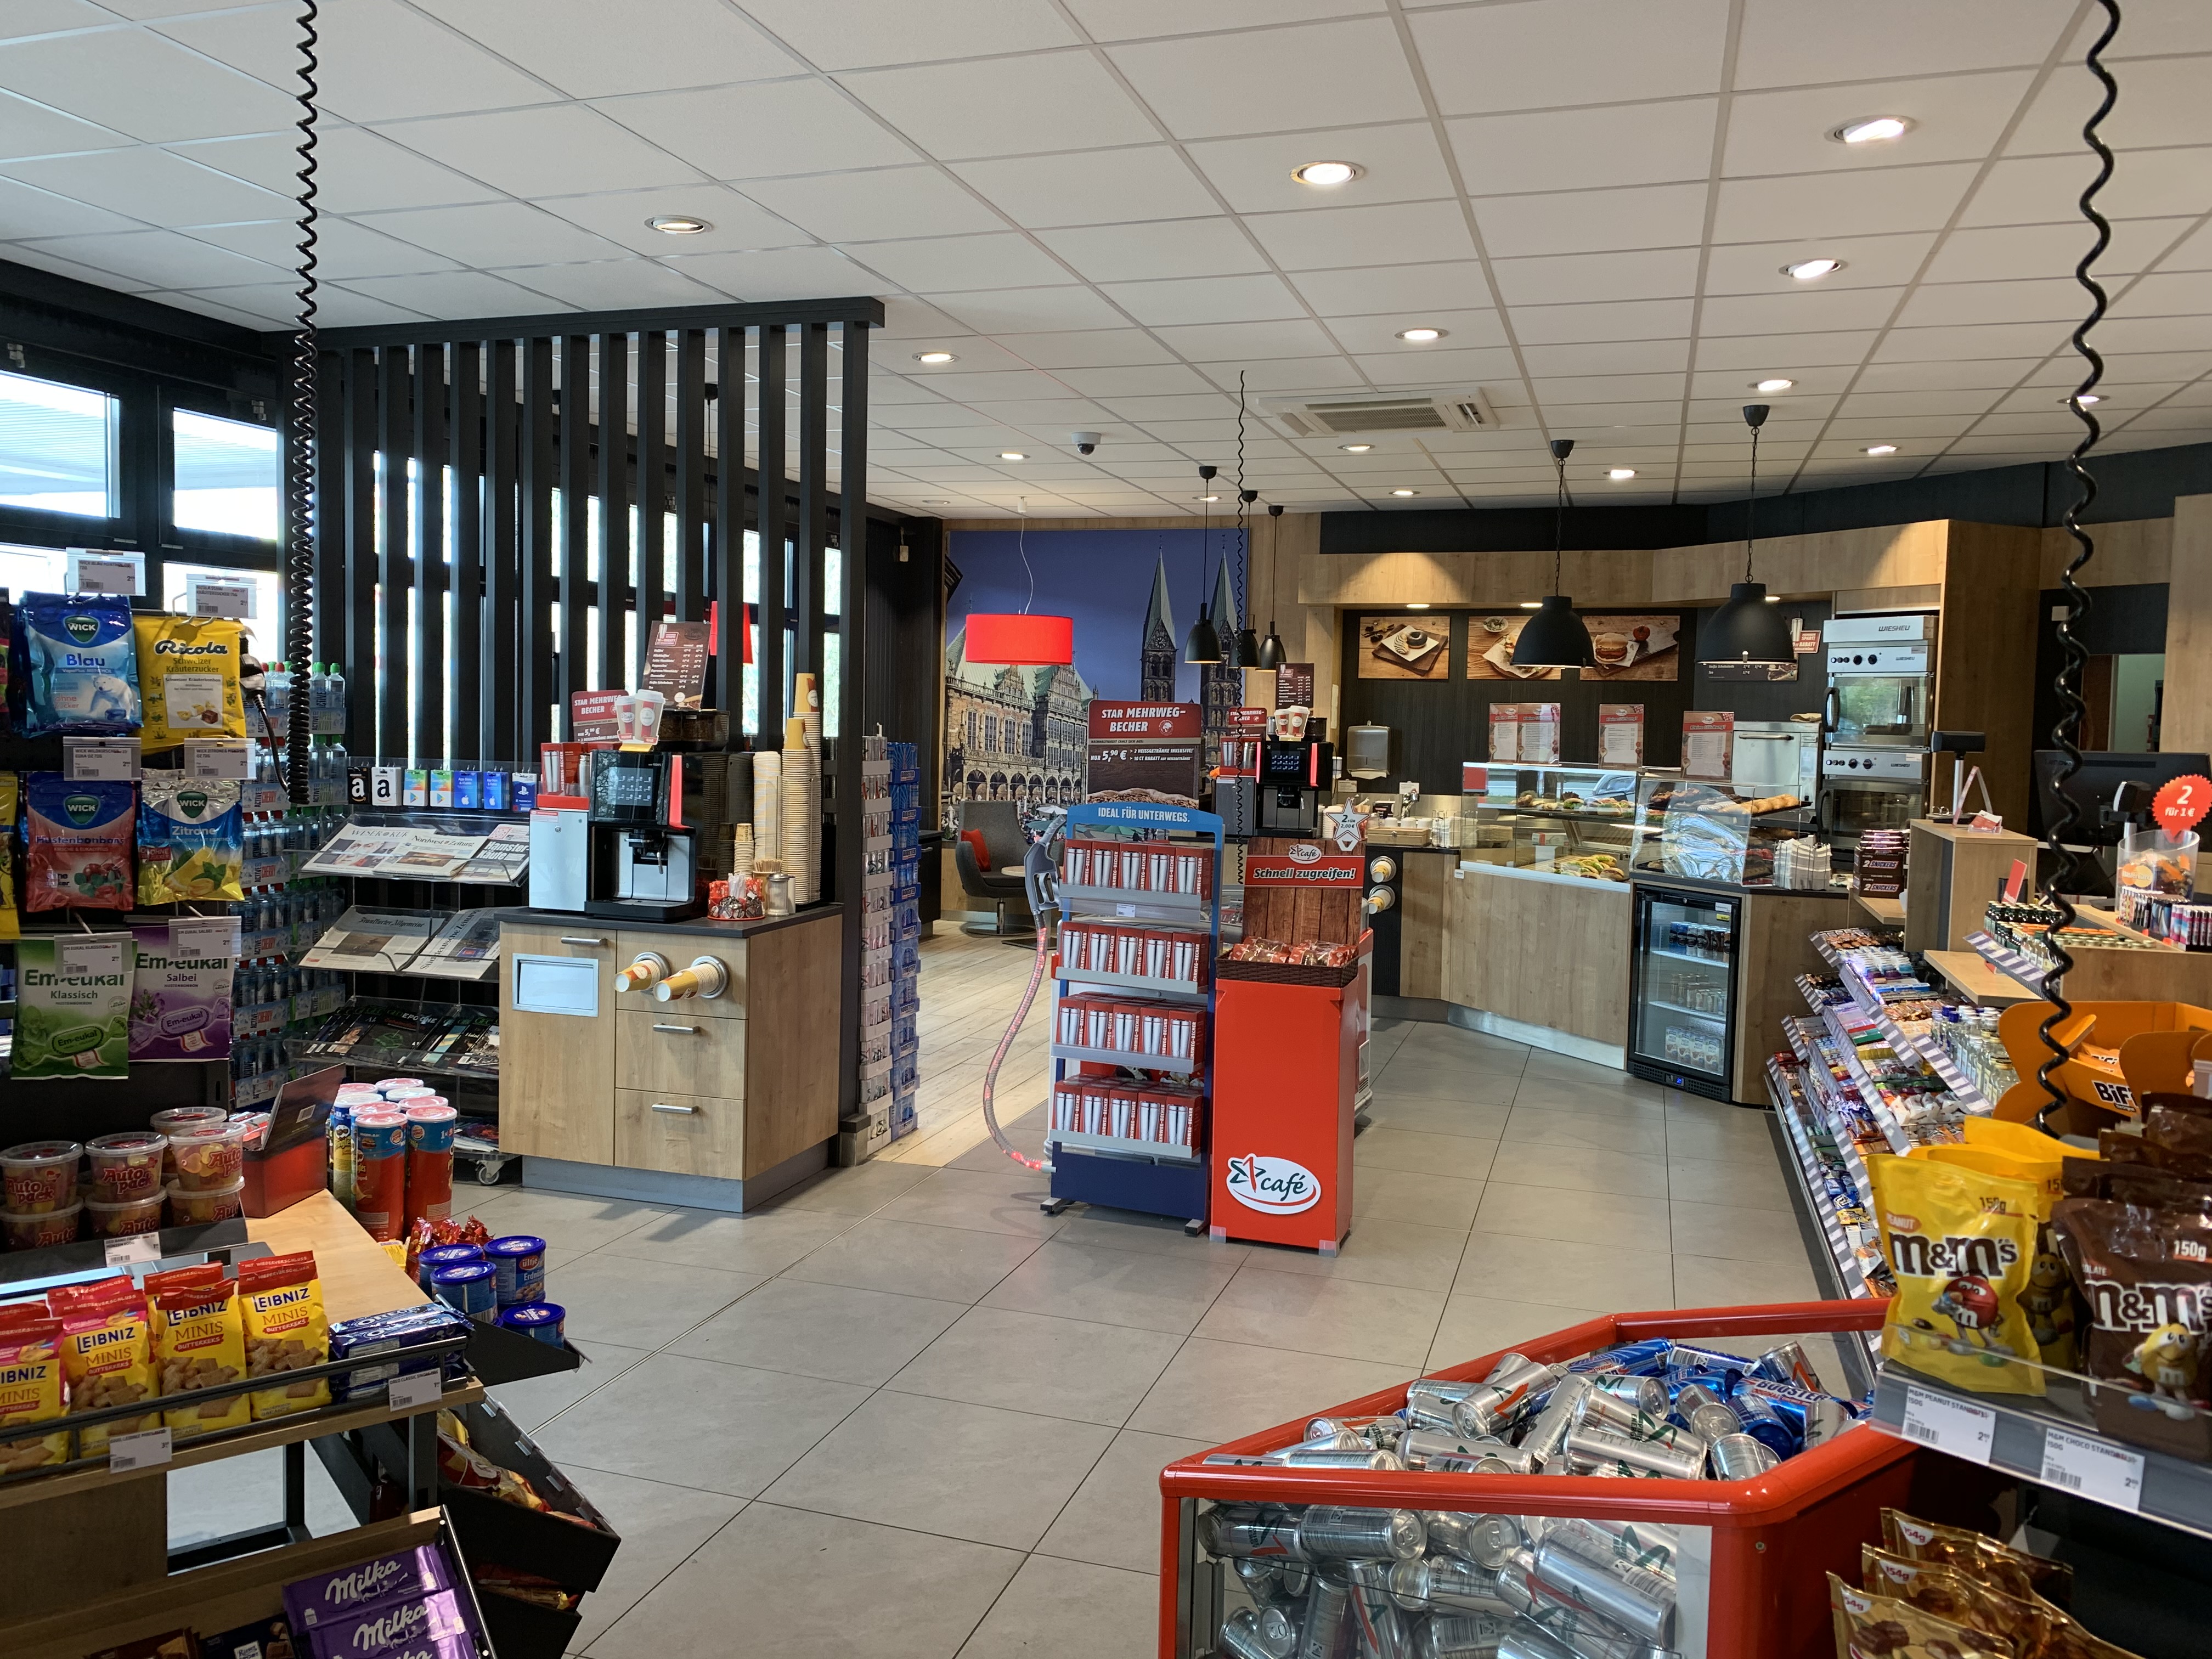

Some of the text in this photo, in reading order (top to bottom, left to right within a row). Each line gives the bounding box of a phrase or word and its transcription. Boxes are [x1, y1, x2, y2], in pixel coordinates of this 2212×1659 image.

[155, 640, 228, 654] Ricola
[66, 653, 105, 667] Blau
[166, 665, 219, 673] Kräuterzucker
[581, 706, 605, 715] BECHER
[1102, 707, 1186, 718] STAR MEHRWEG-
[1109, 721, 1148, 732] BECHER
[1102, 749, 1119, 762] 5,90
[1120, 749, 1127, 761] €
[377, 779, 390, 798] a
[2176, 785, 2193, 805] 2
[67, 804, 95, 812] WICK
[1098, 806, 1190, 823] IDEAL FÜR UNTERWEGS.
[2165, 807, 2196, 817] für 1 €
[1342, 814, 1348, 823] 2
[172, 826, 215, 836] Zitrone
[36, 836, 125, 845] Hustenbonbons
[412, 836, 444, 845] Nordwest
[484, 841, 529, 853] Hamster-
[477, 850, 506, 860] Käufe
[1301, 848, 1317, 861] café
[1254, 867, 1356, 881] Schnell zugreifen!
[358, 917, 426, 928] Frankfurter Allgemeine
[166, 973, 197, 982] Salbei
[50, 990, 98, 1000] Klassisch
[166, 1012, 204, 1028] Em-eukal
[58, 1029, 98, 1046] Em-eukal
[208, 1147, 242, 1168] Auto
[103, 1167, 144, 1184] Auto
[7, 1178, 42, 1193] Auto
[117, 1175, 153, 1194] pack
[1261, 1172, 1308, 1202] café
[16, 1187, 54, 1206] pack
[1979, 1197, 2006, 1215] 150g
[119, 1216, 157, 1235] Auto
[1886, 1214, 1915, 1228] PEANUT
[2174, 1240, 2207, 1262] 150g
[256, 1256, 307, 1267] WIEDERVERSCHLUSS
[522, 1256, 538, 1267] ültje
[76, 1294, 137, 1308] WIEDERVERSCHLUSS
[253, 1288, 311, 1313] LEIBNIZ
[167, 1300, 227, 1327] LEIBNIZ
[262, 1306, 308, 1325] MINIS
[175, 1321, 223, 1342] MINIS
[266, 1319, 306, 1333] BUTTERKEKS
[77, 1327, 136, 1354] LEIBNIZ
[177, 1336, 220, 1350] BUTTERKEKS
[85, 1347, 132, 1367] MINIS
[88, 1361, 129, 1375] BUTTERKEKS
[1755, 1380, 1827, 1403] BOOSTER
[1909, 1388, 1951, 1407] M&M PEANUT
[1908, 1397, 1923, 1407] 150G
[2047, 1431, 2090, 1450] M&M CHOCO
[2047, 1440, 2063, 1452] 150G
[1903, 1526, 1926, 1543] 154g
[1885, 1565, 1910, 1581] 154g
[325, 1560, 402, 1605] Milka
[353, 1605, 430, 1651] Milka
